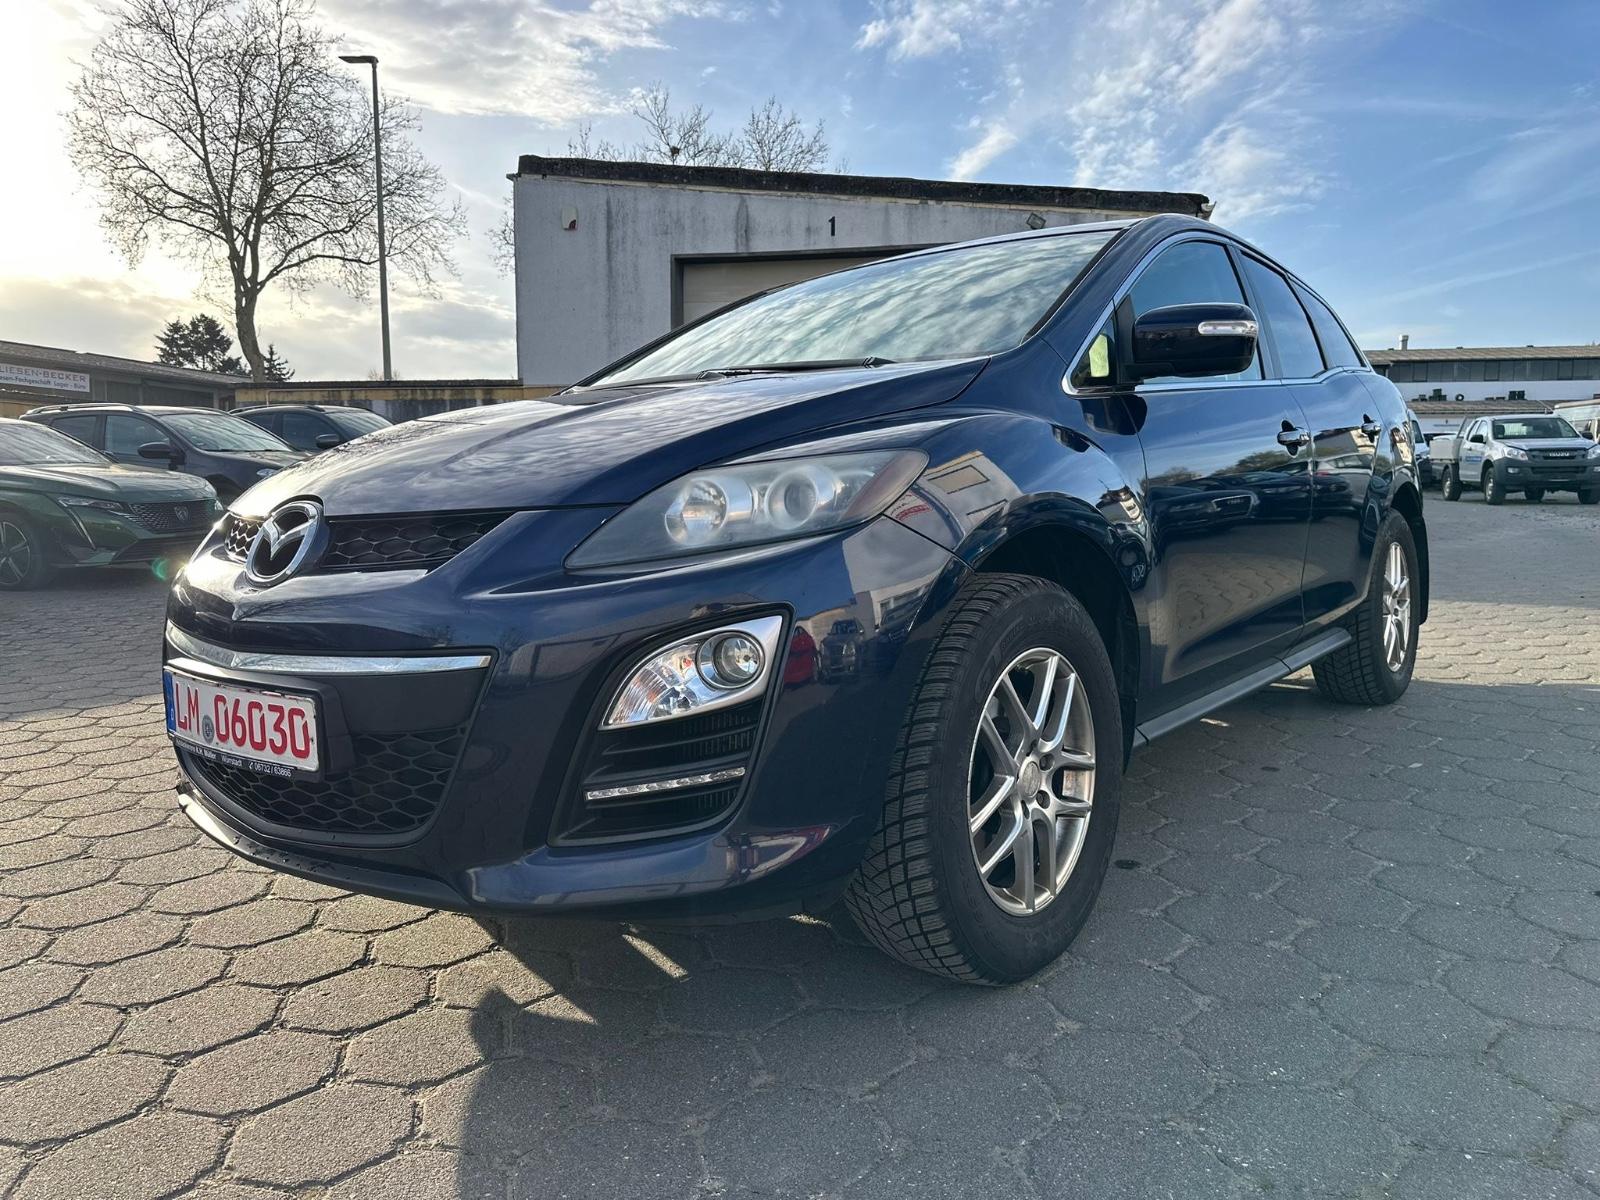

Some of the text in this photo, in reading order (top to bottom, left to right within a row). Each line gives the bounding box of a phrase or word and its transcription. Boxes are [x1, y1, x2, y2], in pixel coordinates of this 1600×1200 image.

[828, 216, 836, 237] 1
[175, 682, 200, 734] LM
[213, 694, 311, 759] 06030
